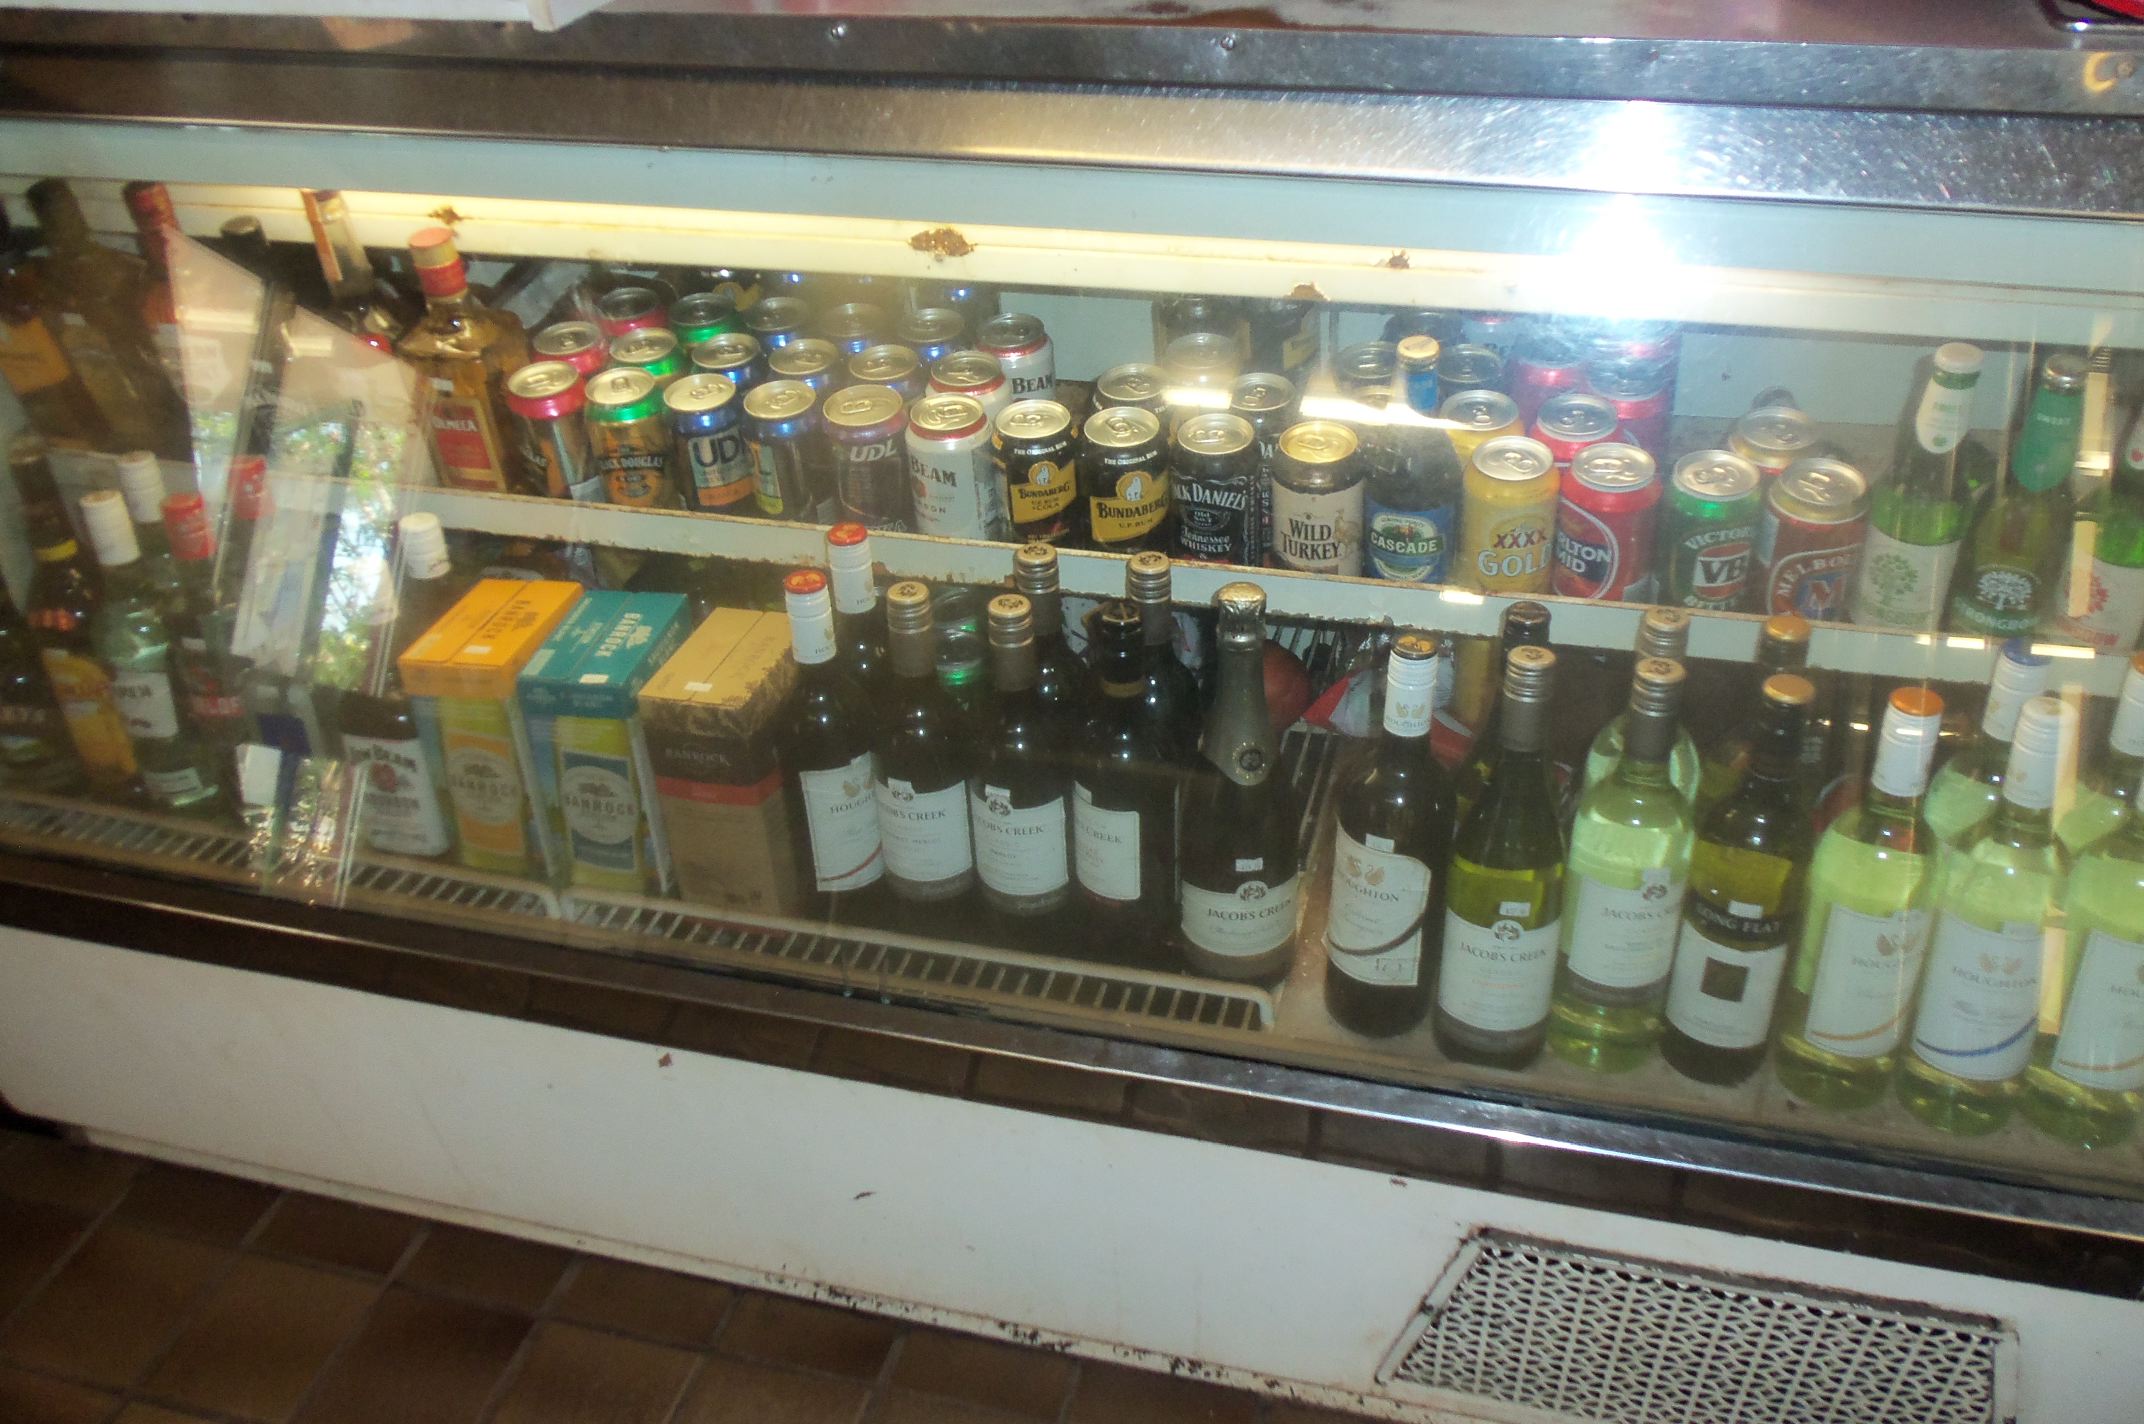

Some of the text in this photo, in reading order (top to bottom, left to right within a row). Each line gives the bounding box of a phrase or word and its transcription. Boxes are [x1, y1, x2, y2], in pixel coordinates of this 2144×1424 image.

[849, 440, 898, 462] UDL
[911, 456, 957, 488] BEAM
[1019, 481, 1070, 499] BUNDABERG
[1096, 493, 1165, 519] BUNDABERG
[1289, 518, 1332, 542] WILD
[1494, 529, 1546, 549] XXXX
[1180, 538, 1232, 554] WHISKEY
[1281, 532, 1343, 561] TURKEY
[1371, 532, 1438, 554] CASCADE
[1558, 530, 1610, 562] RLTON
[908, 810, 946, 821] CREEK
[1005, 826, 1044, 837] CREEK
